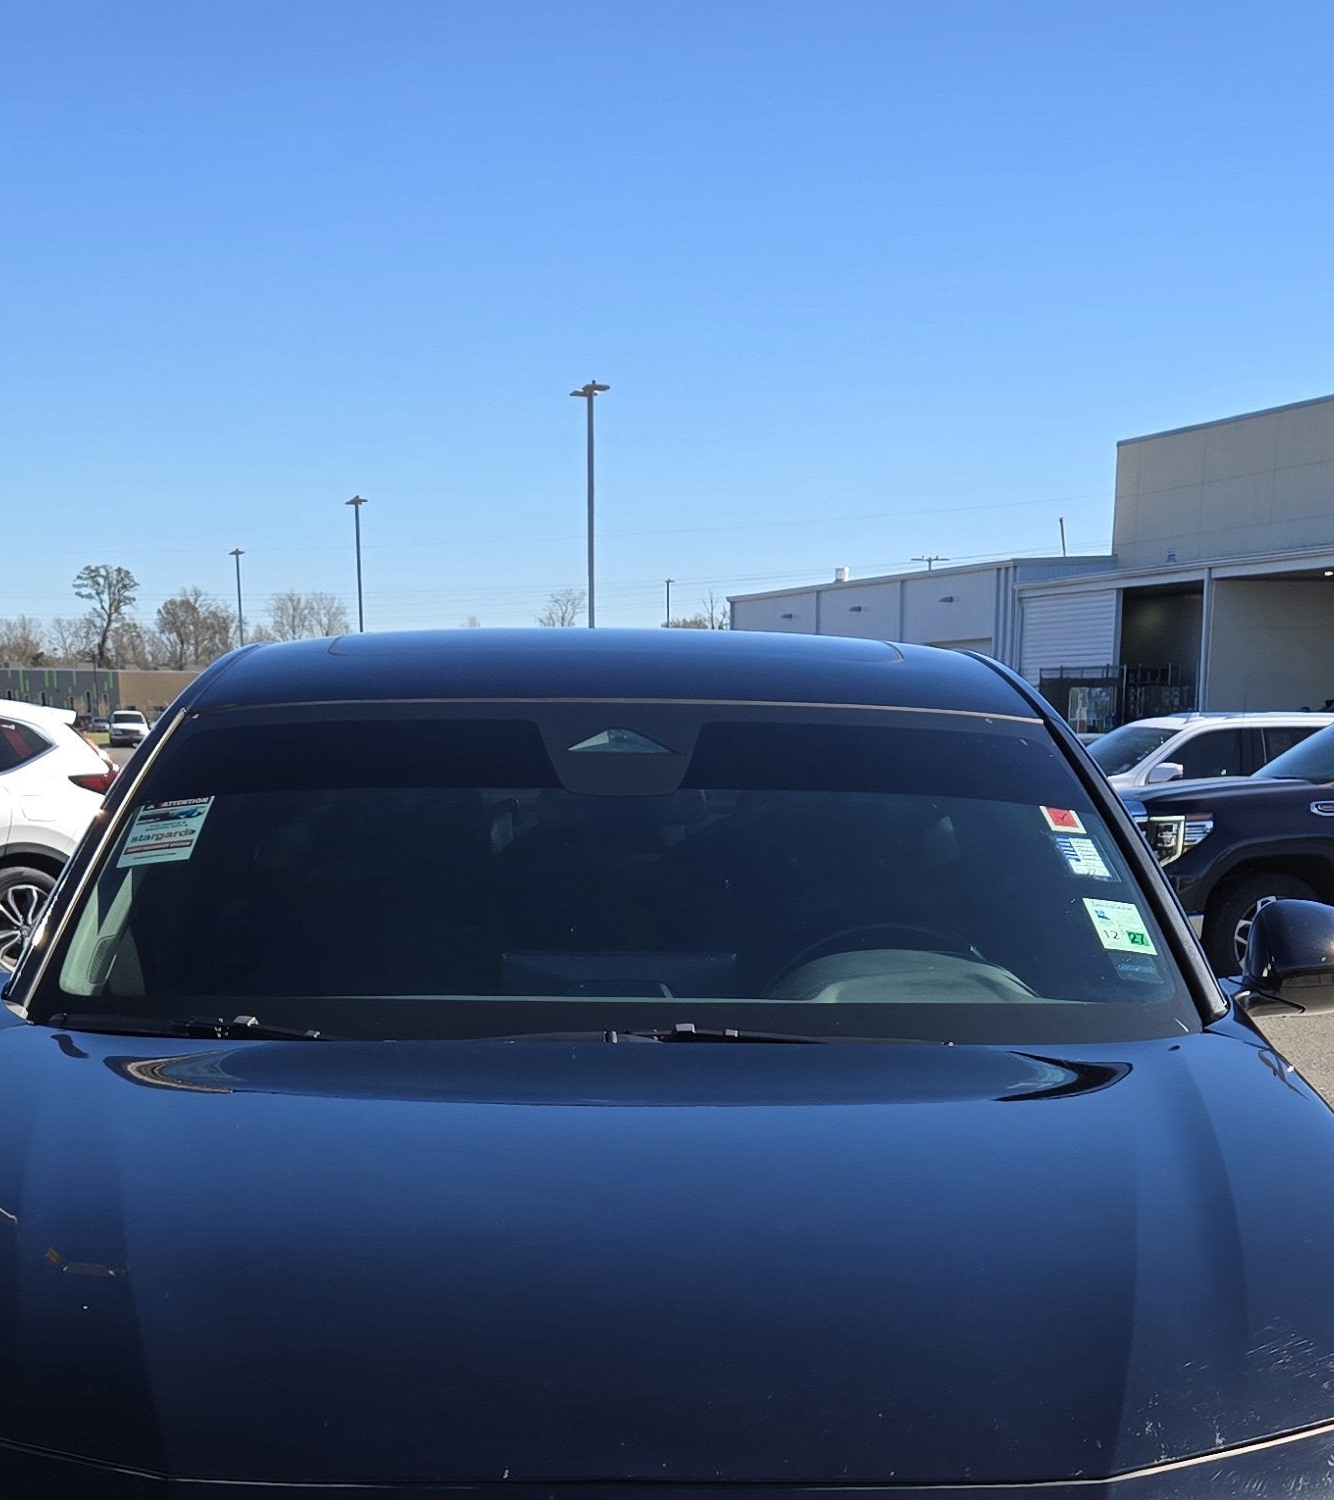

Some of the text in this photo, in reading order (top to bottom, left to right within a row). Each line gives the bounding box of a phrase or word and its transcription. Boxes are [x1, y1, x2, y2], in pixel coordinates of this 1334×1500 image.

[160, 796, 209, 808] ATTENTION
[1103, 929, 1121, 941] 12
[1127, 931, 1146, 946] 27
